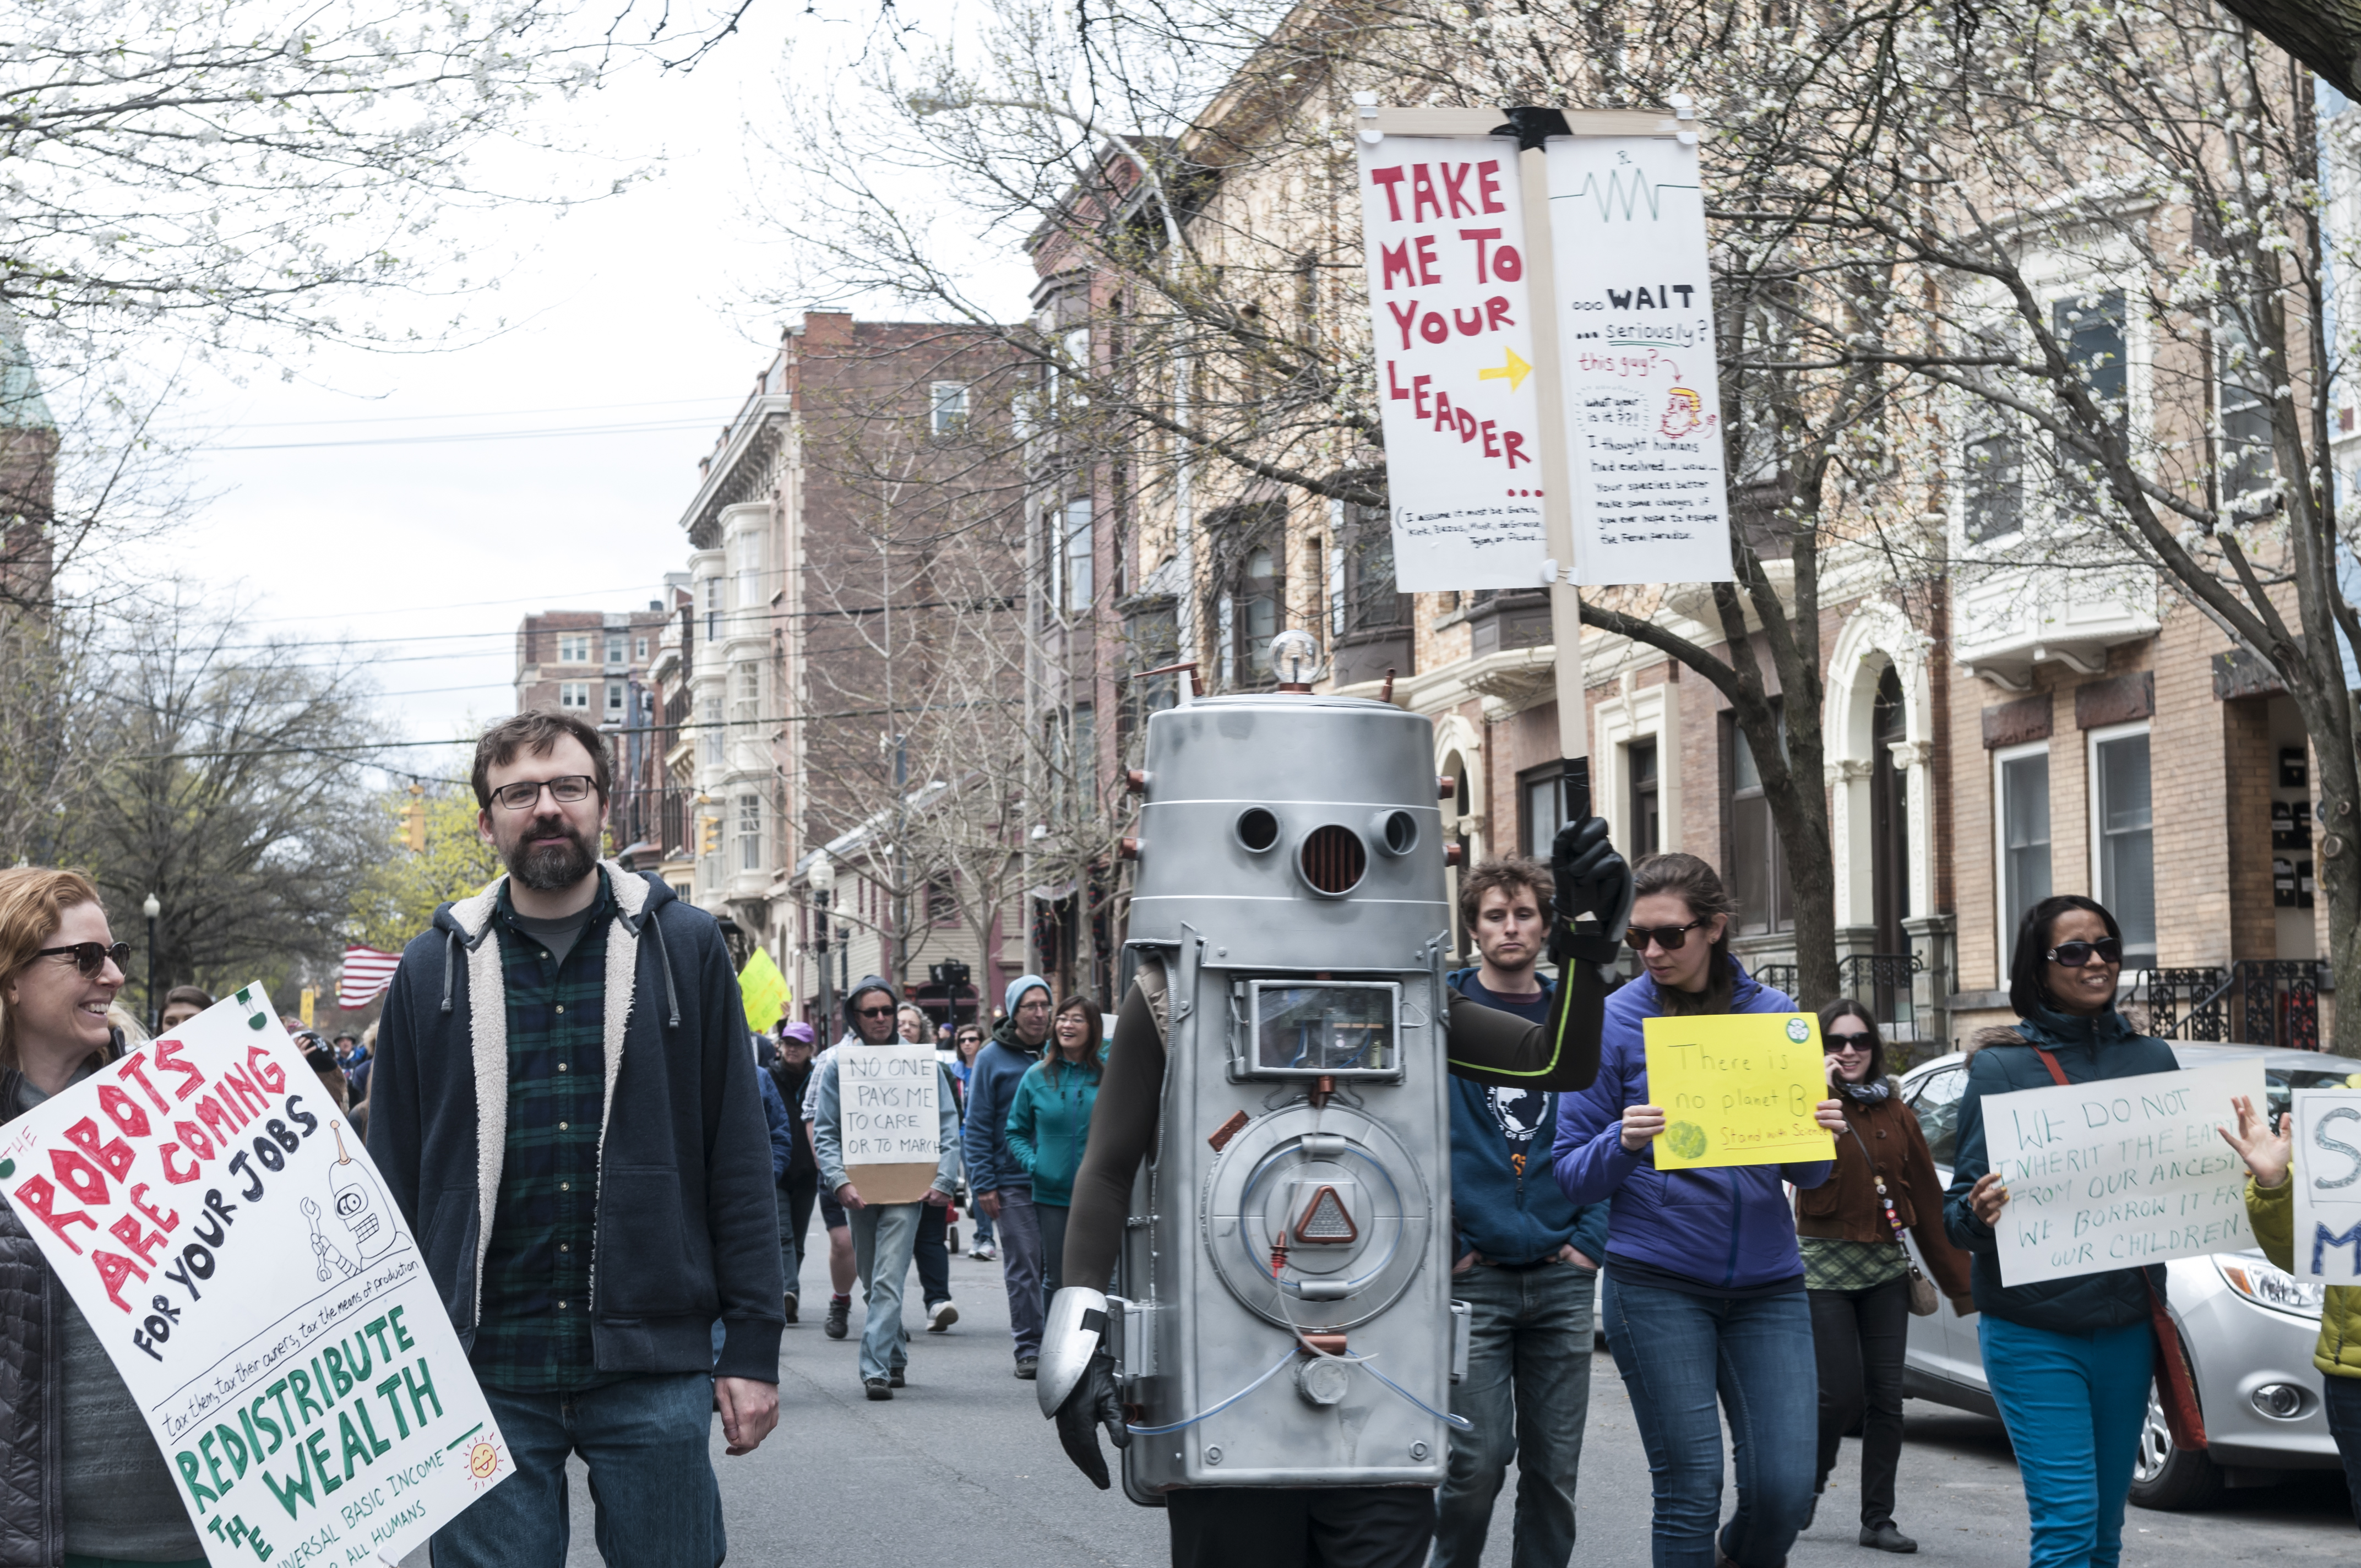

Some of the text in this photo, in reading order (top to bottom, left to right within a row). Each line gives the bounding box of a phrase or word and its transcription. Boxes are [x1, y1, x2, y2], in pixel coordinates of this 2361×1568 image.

[1371, 160, 1506, 223] TAKE
[1380, 228, 1521, 290] ME TO
[1386, 296, 1516, 351] YOUR
[1578, 349, 1659, 377] this guy?
[1386, 360, 1532, 469] LEADER
[1586, 435, 1700, 455] I thought humans
[1590, 459, 1616, 472] had
[850, 1057, 933, 1077] NO ONE
[1667, 1043, 1788, 1071] There is
[846, 1112, 921, 1131] TO CARE
[858, 1085, 933, 1108] PAYS ME
[1675, 1084, 1807, 1117] no planet B
[2013, 1087, 2190, 1151] WE DO NOT
[1, 1124, 37, 1157] THE
[14, 1040, 205, 1255] ROBOTS
[848, 1138, 941, 1154] OR TO MARCH
[1720, 1123, 1829, 1145] Stand with Science
[1996, 1118, 2239, 1186] INHERIT THE EART
[91, 1046, 286, 1315] ARE COMING
[2011, 1151, 2236, 1214] FROM OUR ANCEST
[133, 1095, 318, 1362] FOR YOUR JOBS
[2018, 1184, 2240, 1248] WE BORROW IT FR
[2051, 1242, 2095, 1267] OUR
[162, 1260, 419, 1437] tax them, tax their owners, tax the means of production
[175, 1304, 415, 1515] REDISTRIBUTE
[207, 1357, 443, 1562] THE WEALTH
[276, 1451, 445, 1568] VERSAL BASIC INCOME
[346, 1499, 426, 1566] ALL HUMANS
